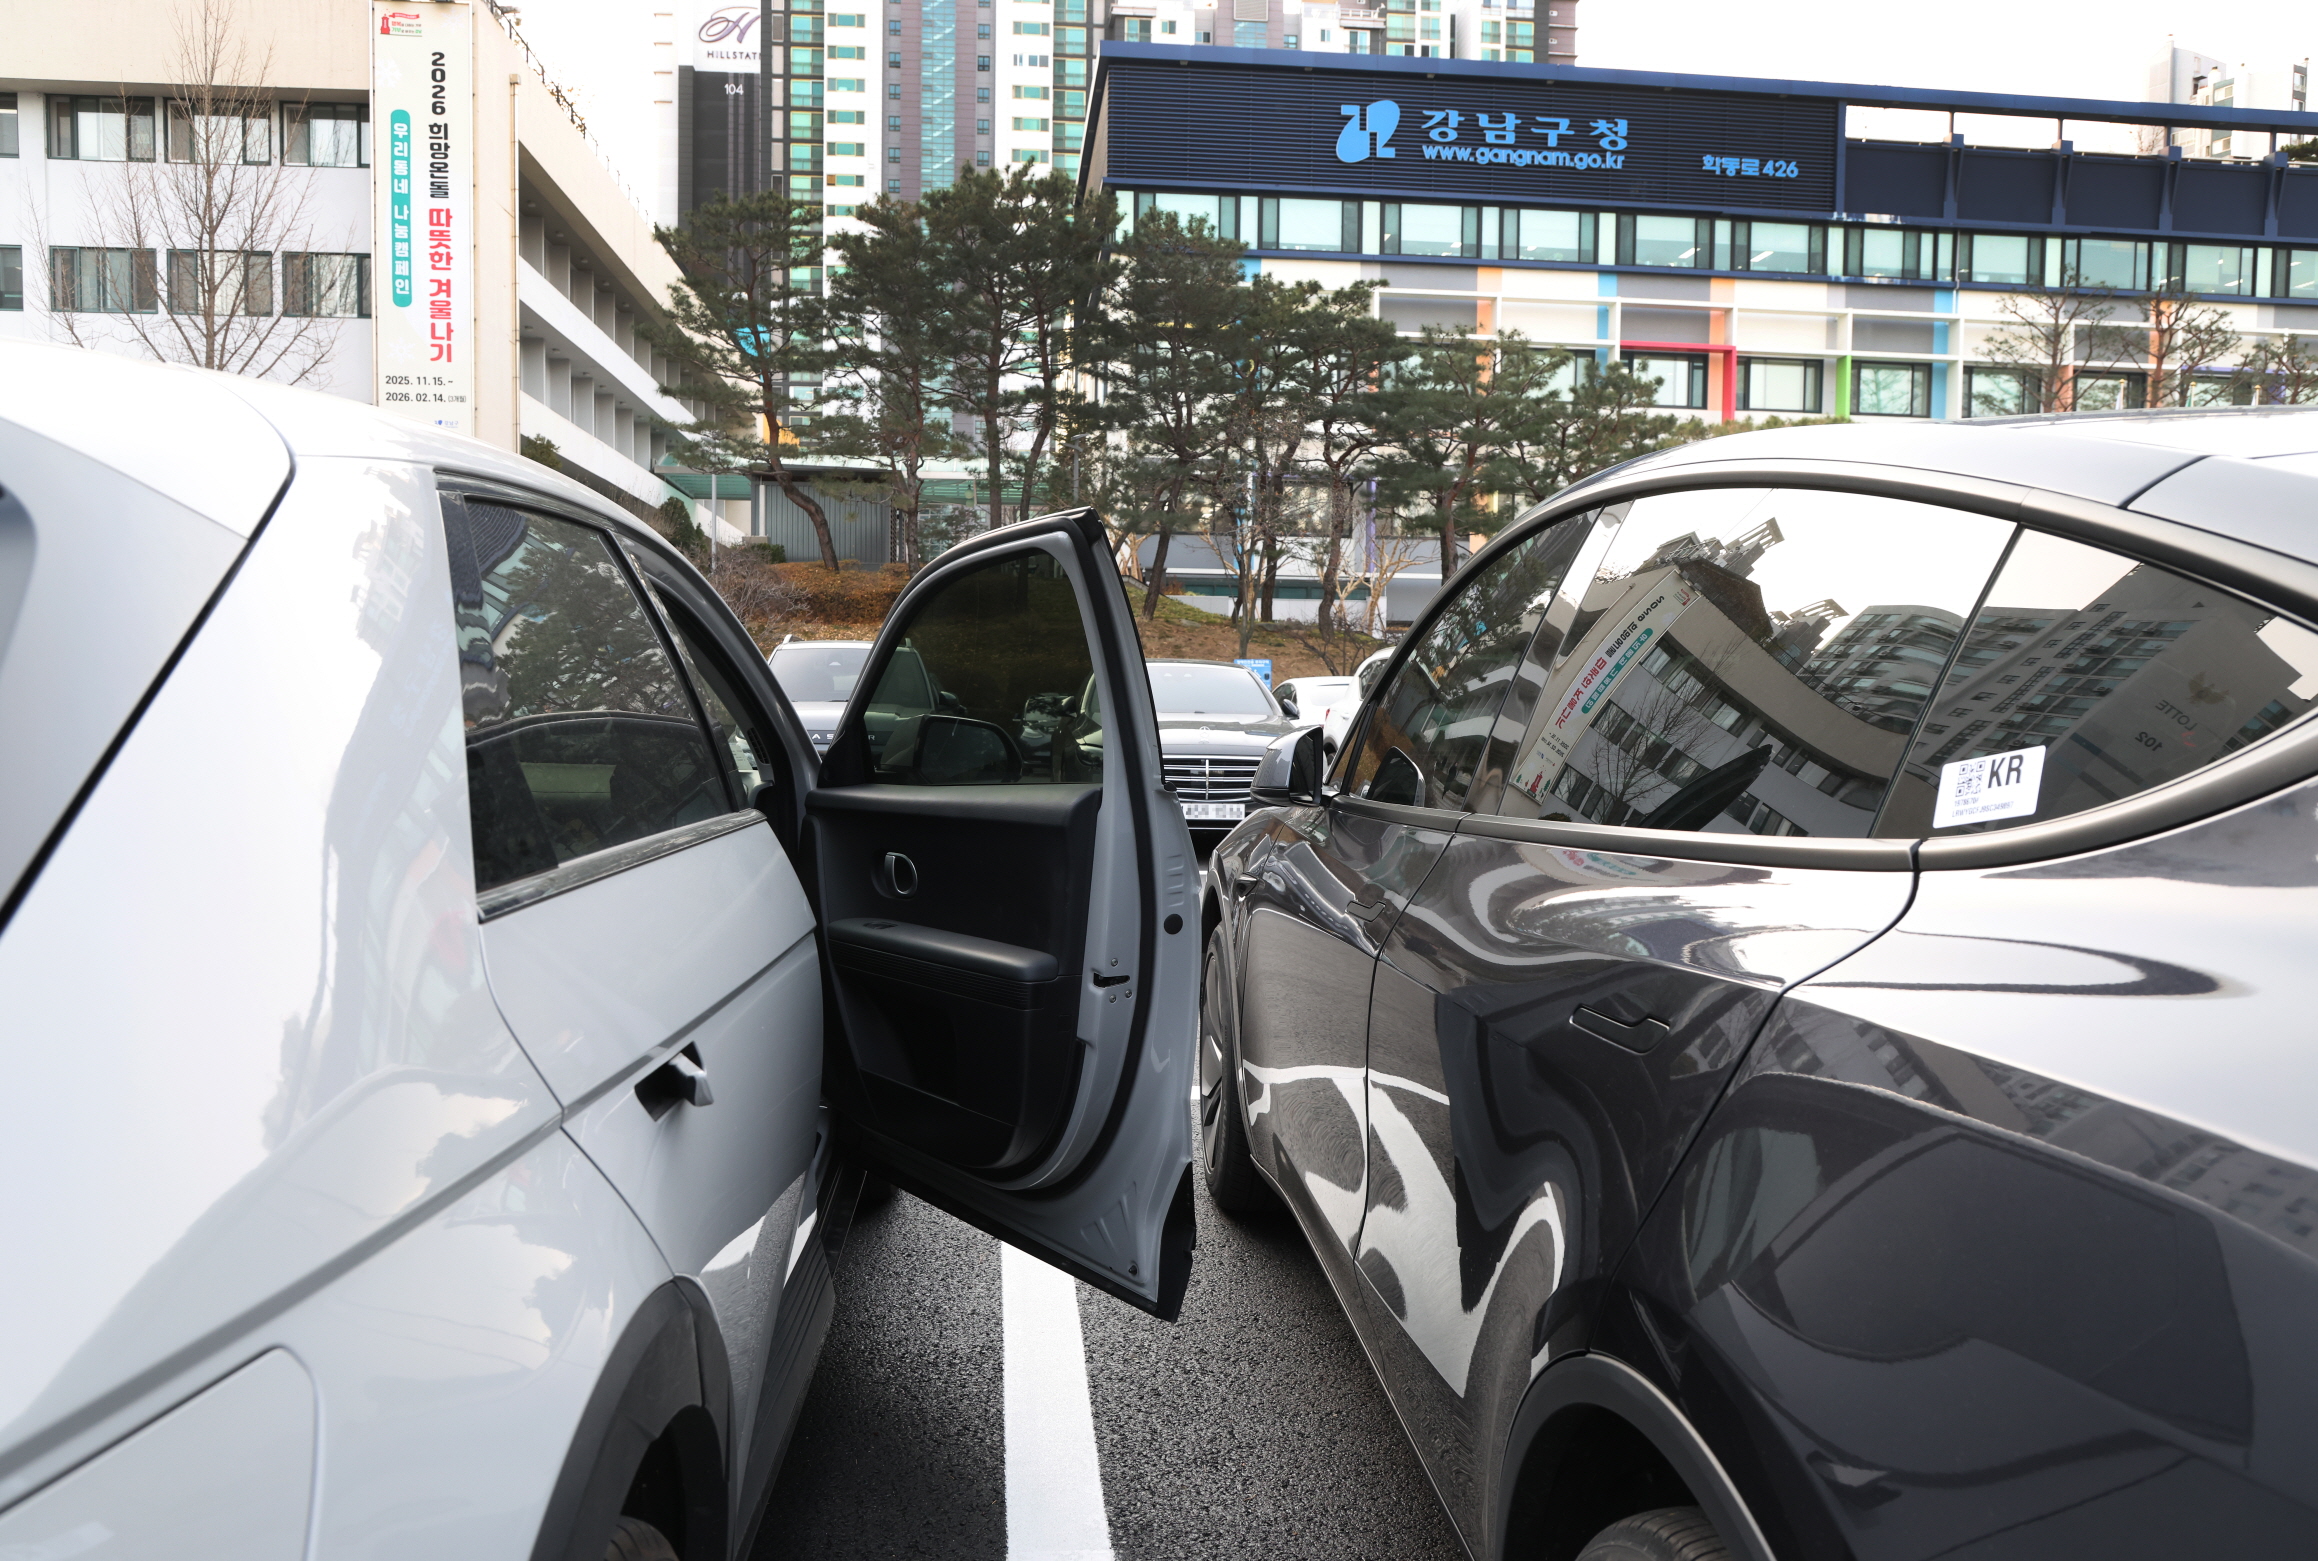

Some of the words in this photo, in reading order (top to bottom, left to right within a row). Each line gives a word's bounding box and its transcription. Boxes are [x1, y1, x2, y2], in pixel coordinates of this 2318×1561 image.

[431, 52, 446, 116] 2026
[724, 83, 744, 95] 104
[1421, 109, 1629, 152] 강남구청
[393, 122, 409, 194] 우리동네
[428, 122, 450, 199] 희망온돌
[1422, 143, 1625, 170] www.gangnam.go.kr
[1701, 154, 1759, 177] 학동로
[1763, 159, 1799, 178] 426
[394, 205, 410, 295] 나눔캠페인
[428, 208, 453, 271] 따뜻한
[428, 278, 454, 363] 겨울나기
[385, 375, 413, 385] 2025.
[417, 376, 430, 385] 11.
[385, 392, 413, 402] 2026.
[416, 393, 431, 402] 02.
[1988, 754, 2024, 789] KR
